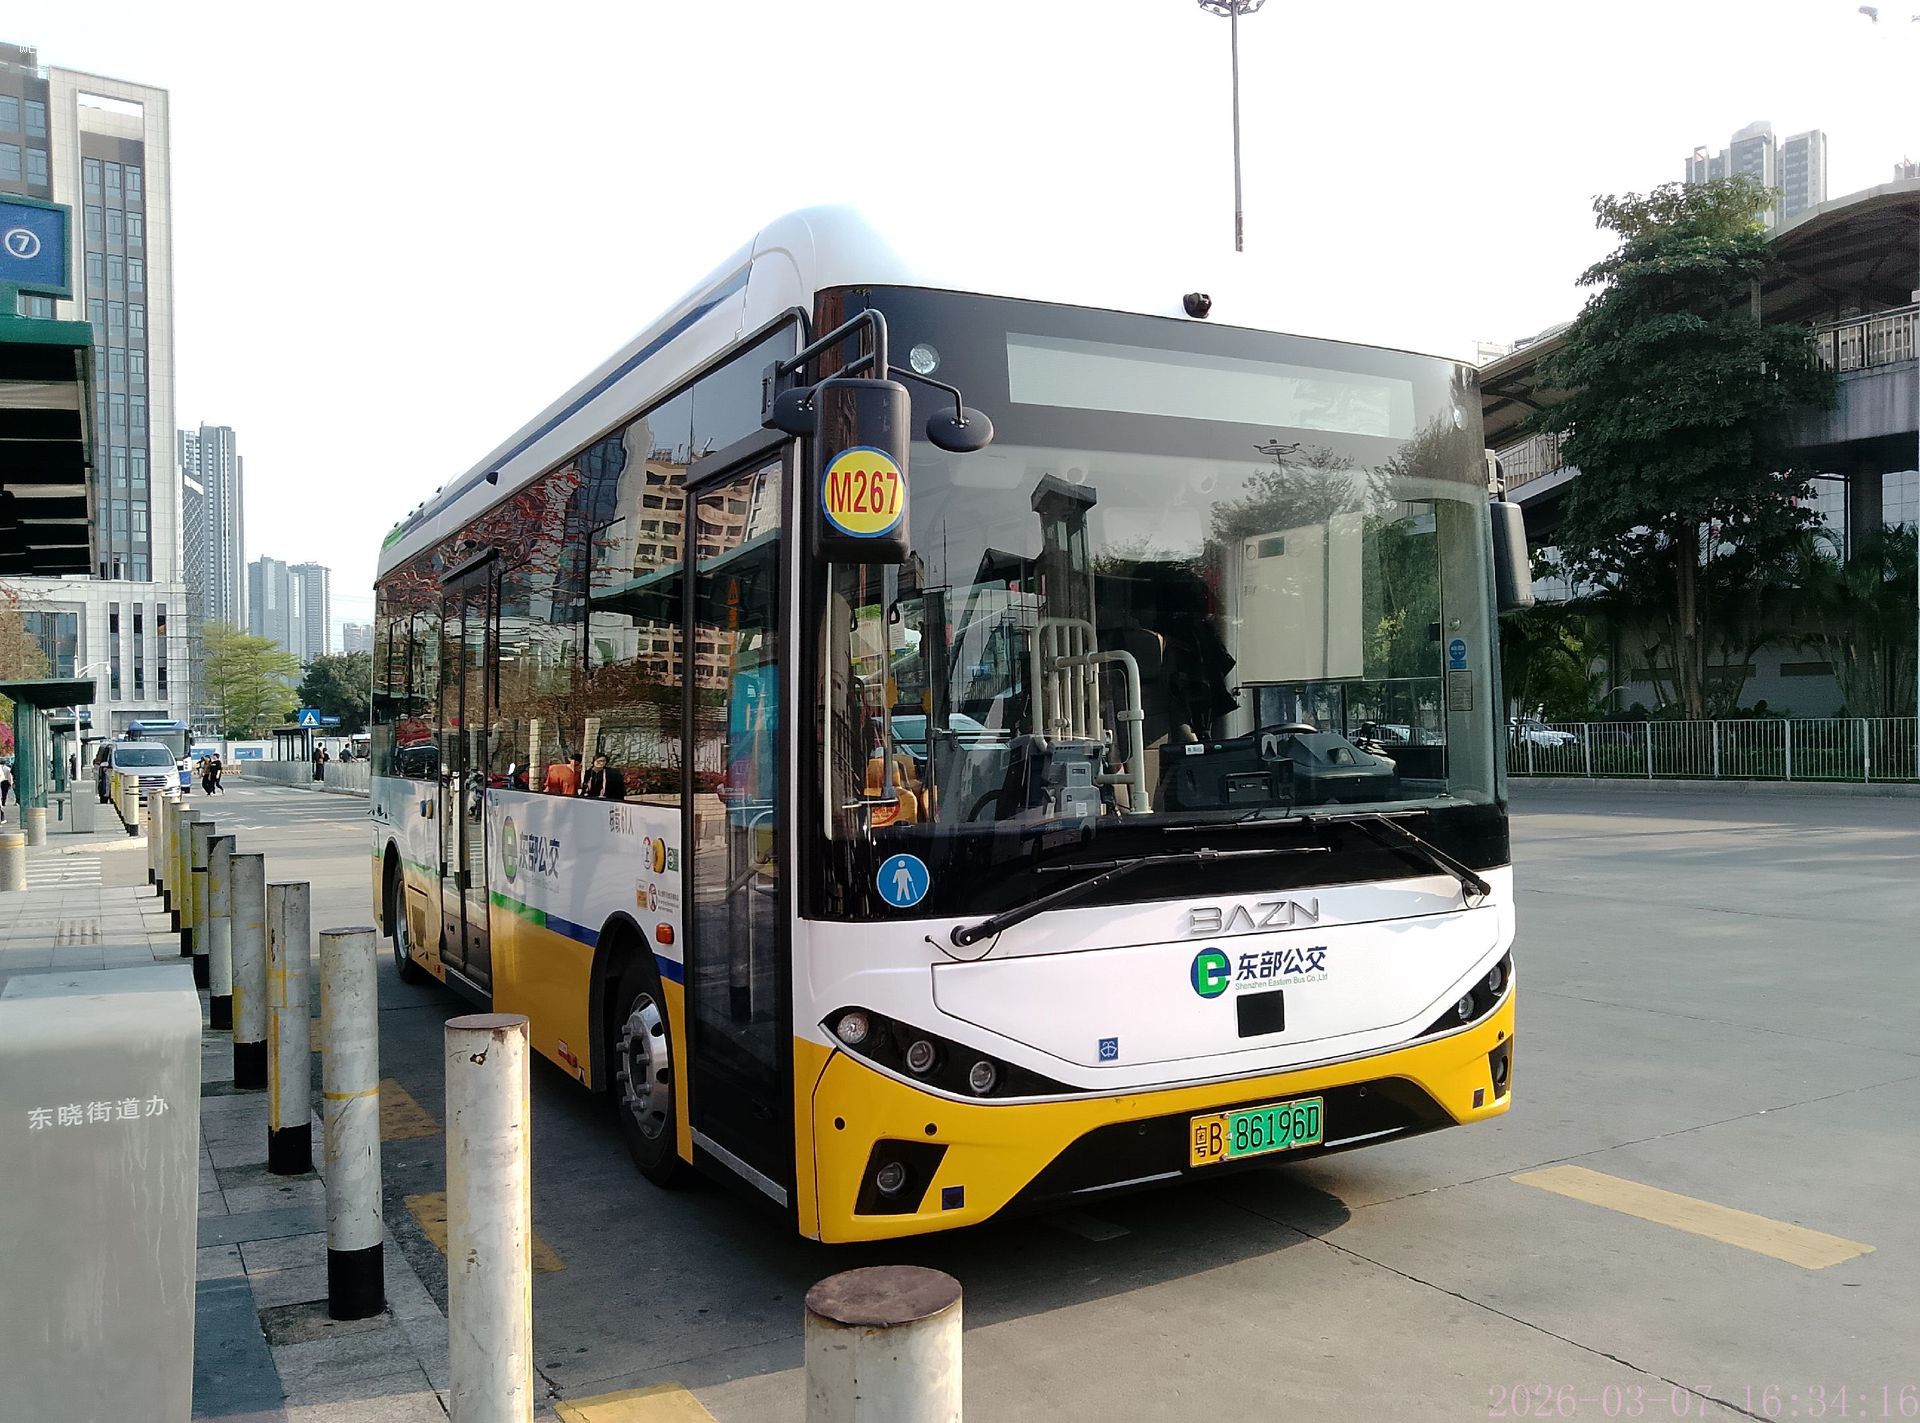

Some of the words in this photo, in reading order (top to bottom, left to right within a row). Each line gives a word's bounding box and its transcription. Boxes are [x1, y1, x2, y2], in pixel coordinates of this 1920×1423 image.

[830, 469, 899, 515] M267
[1236, 945, 1328, 981] 东部公交
[1293, 973, 1306, 984] Bus
[27, 1094, 169, 1131] 东晓街道办
[1236, 1106, 1320, 1150] 86196D
